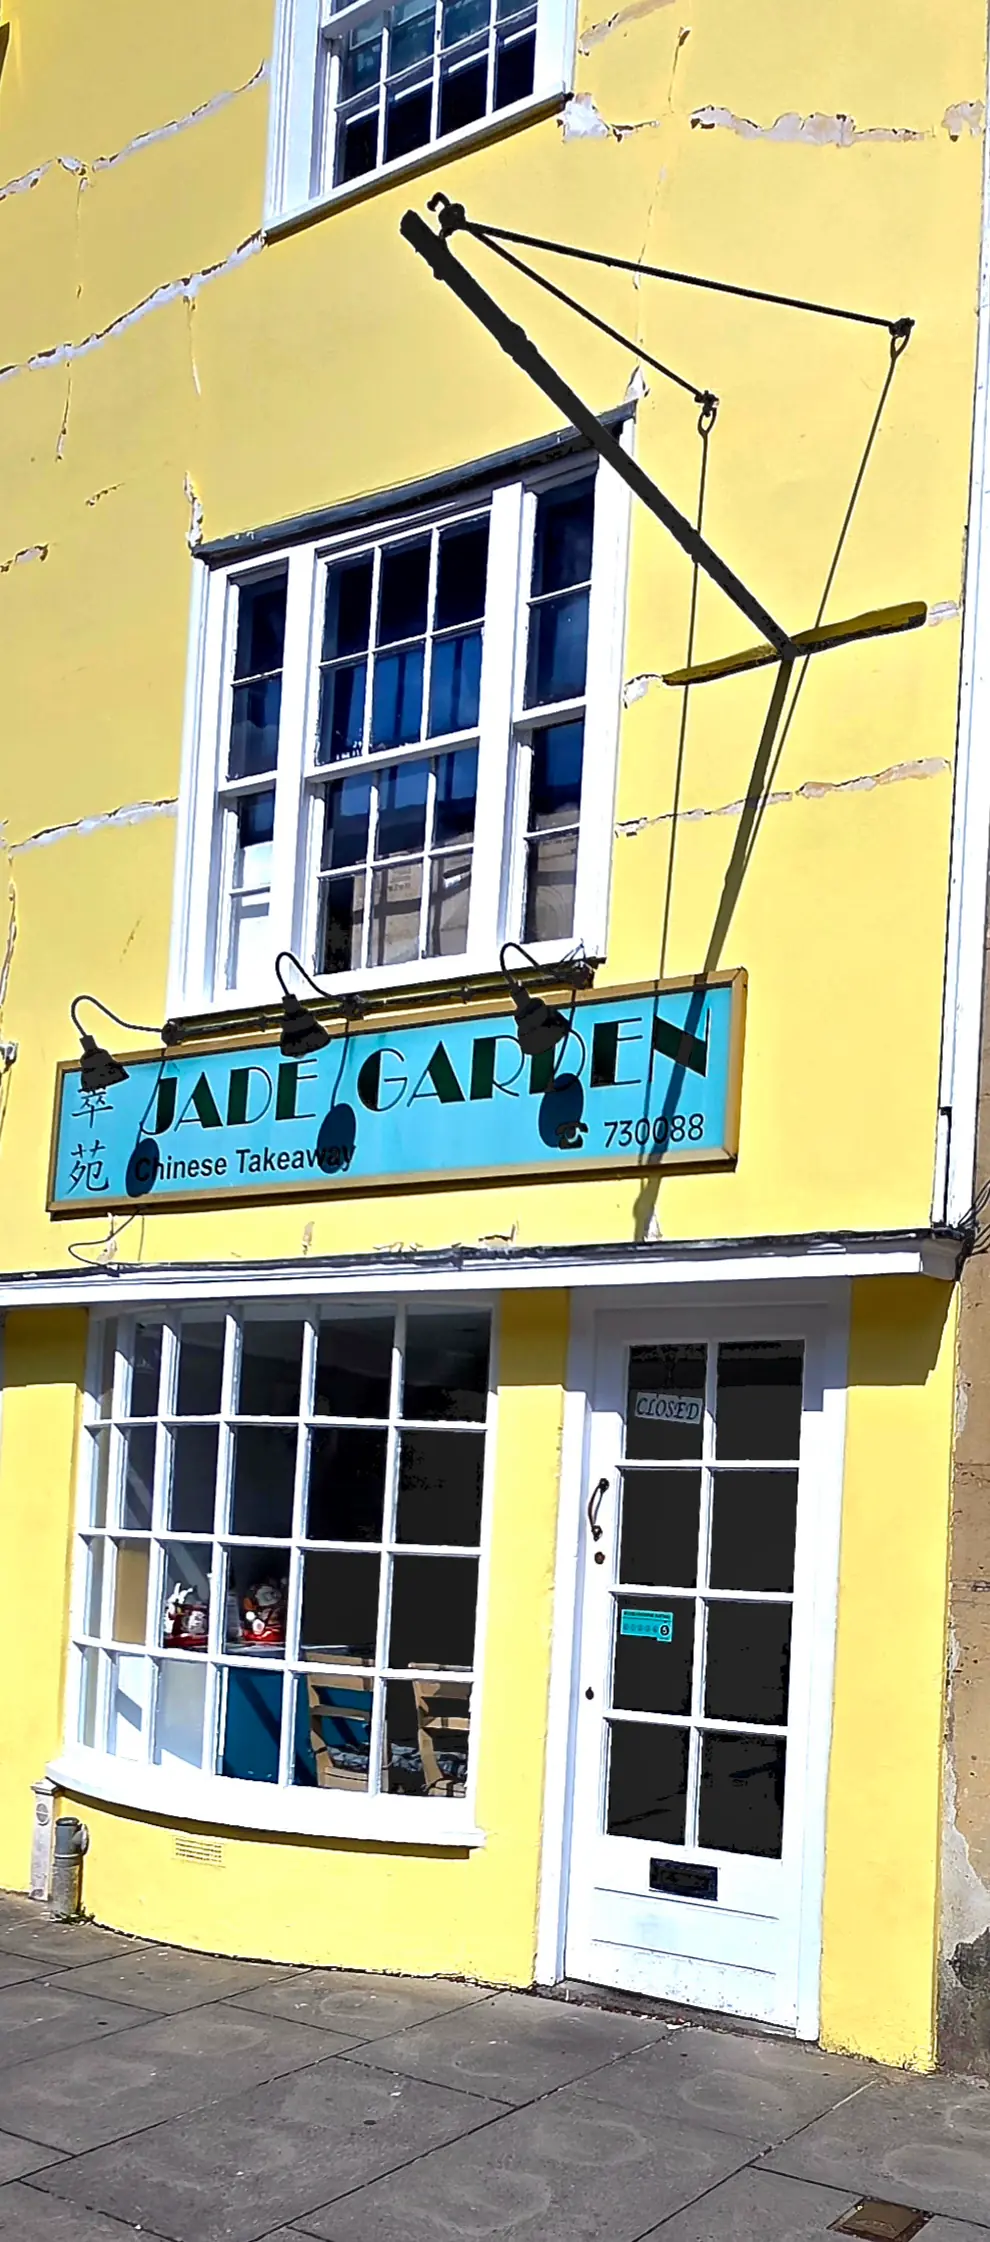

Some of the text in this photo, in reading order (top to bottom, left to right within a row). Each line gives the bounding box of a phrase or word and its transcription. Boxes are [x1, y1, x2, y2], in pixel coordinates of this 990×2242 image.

[140, 1007, 711, 1136] JADE GARDEN
[603, 1113, 705, 1148] 730088
[134, 1144, 357, 1183] Chinese Takeaway
[636, 1396, 700, 1420] CLOSED
